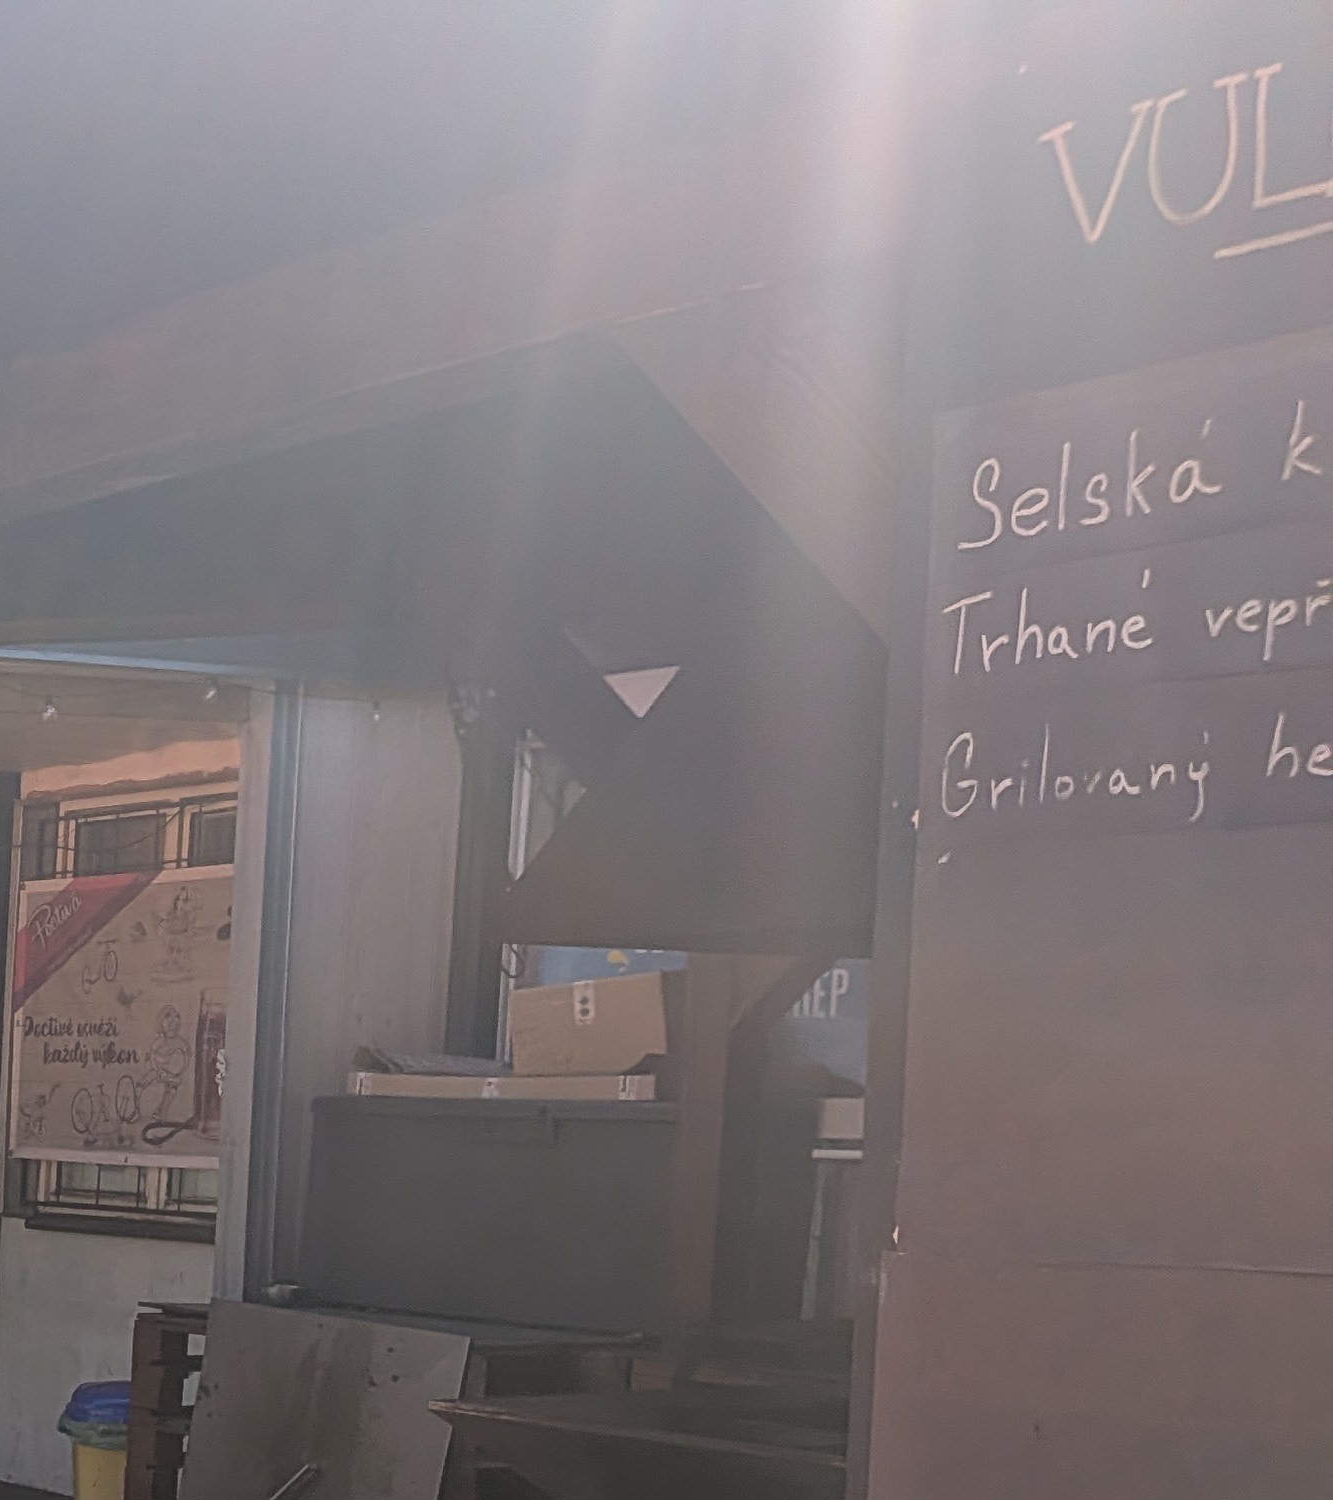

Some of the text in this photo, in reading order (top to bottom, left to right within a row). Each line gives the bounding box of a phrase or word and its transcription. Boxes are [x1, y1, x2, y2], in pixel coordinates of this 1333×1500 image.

[957, 418, 1222, 550] Selská
[942, 568, 1333, 674] Trhané vepř
[941, 712, 1333, 823] Grilovaný he
